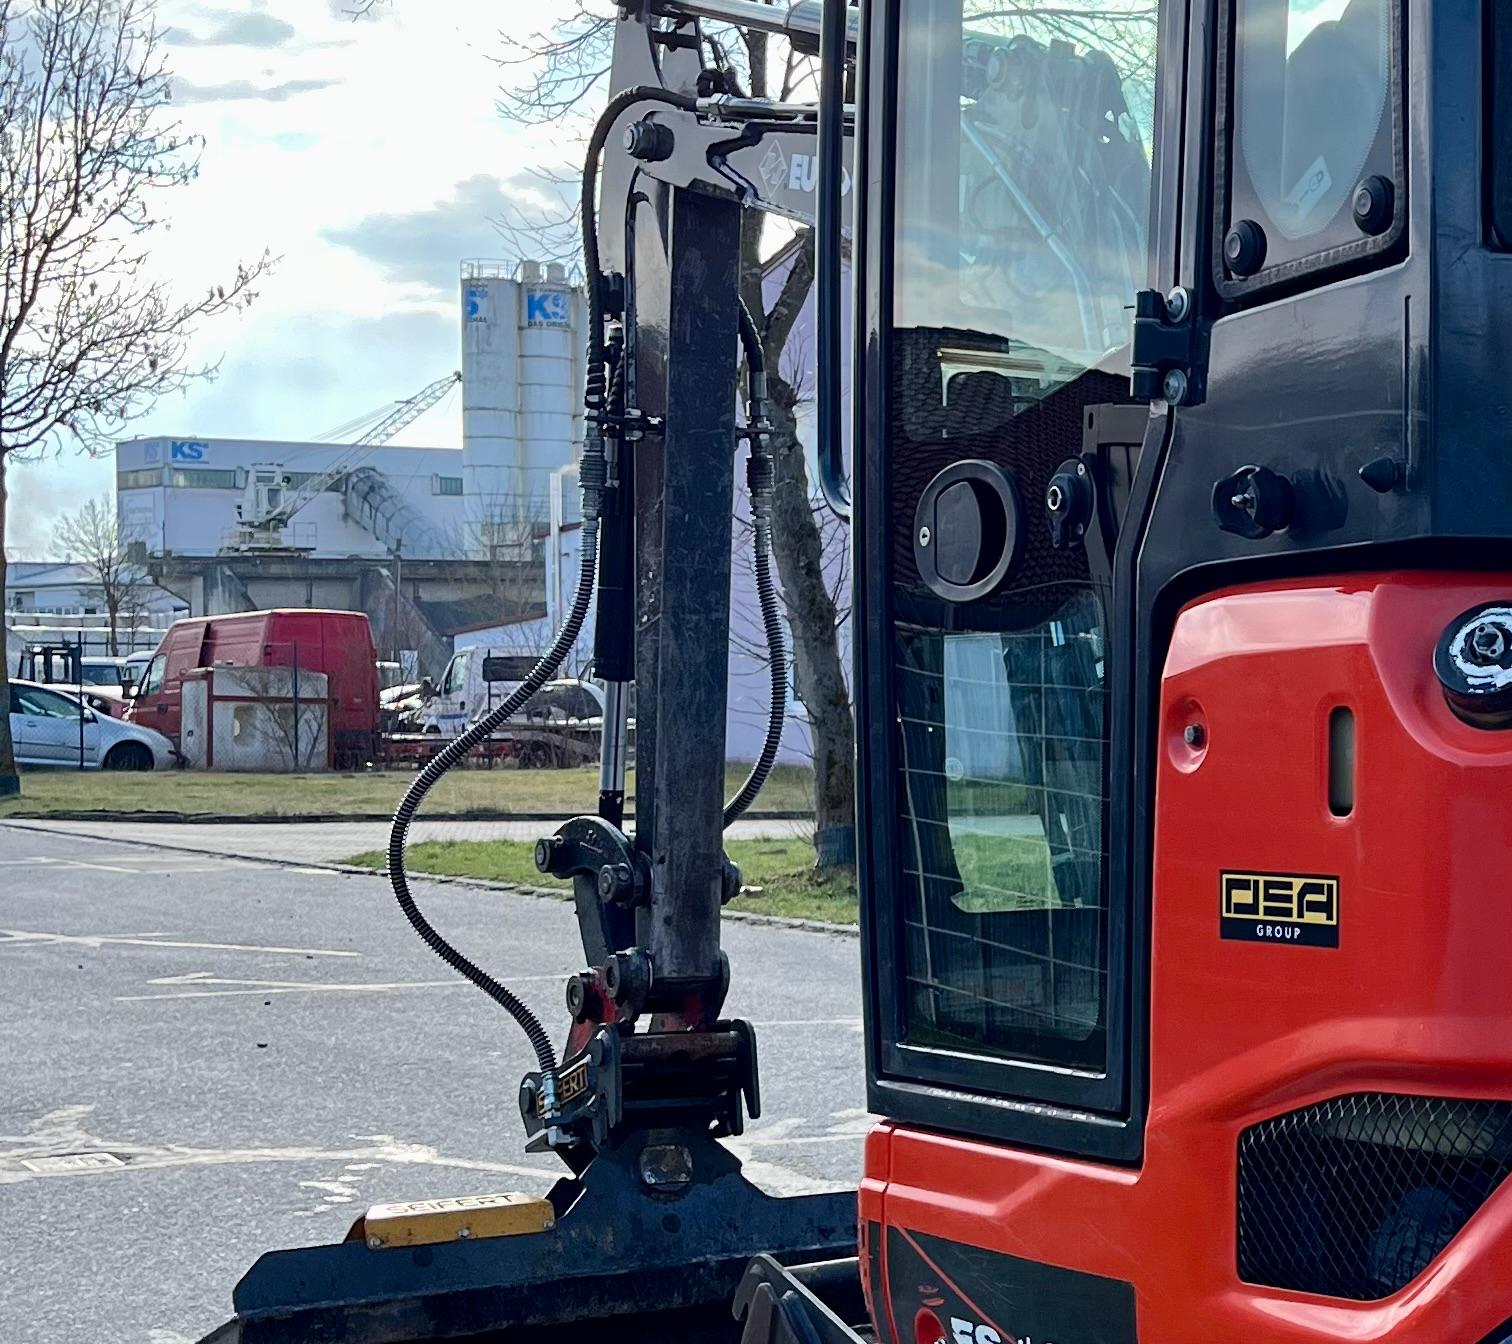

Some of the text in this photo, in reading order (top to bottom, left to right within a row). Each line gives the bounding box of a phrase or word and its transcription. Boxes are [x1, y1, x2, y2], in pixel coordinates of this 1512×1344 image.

[171, 441, 203, 459] KS
[1256, 924, 1301, 939] GROUP
[386, 1194, 513, 1214] SEIFERT
